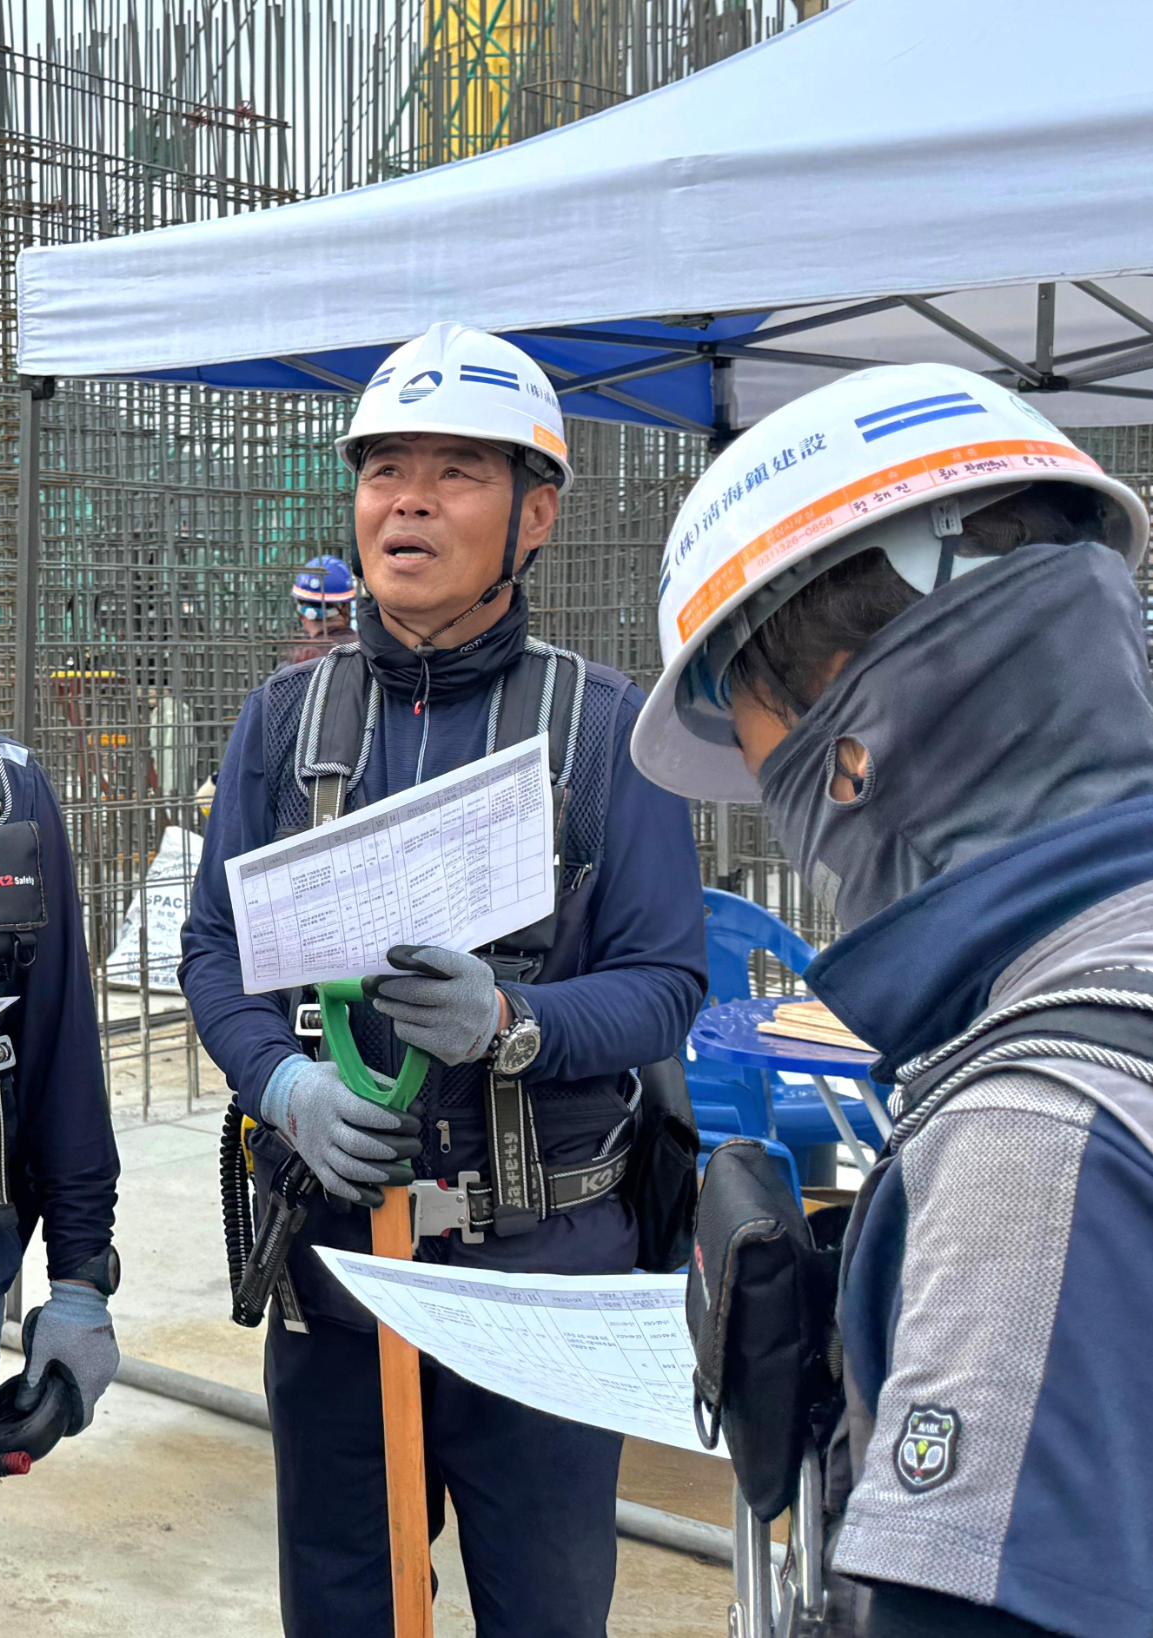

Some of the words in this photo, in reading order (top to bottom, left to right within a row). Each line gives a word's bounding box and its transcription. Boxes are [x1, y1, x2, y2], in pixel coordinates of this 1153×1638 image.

[757, 516, 834, 567] 031)326-0858
[14, 875, 35, 886] Safety
[145, 894, 192, 910] SPAC
[581, 1168, 614, 1195] K2
